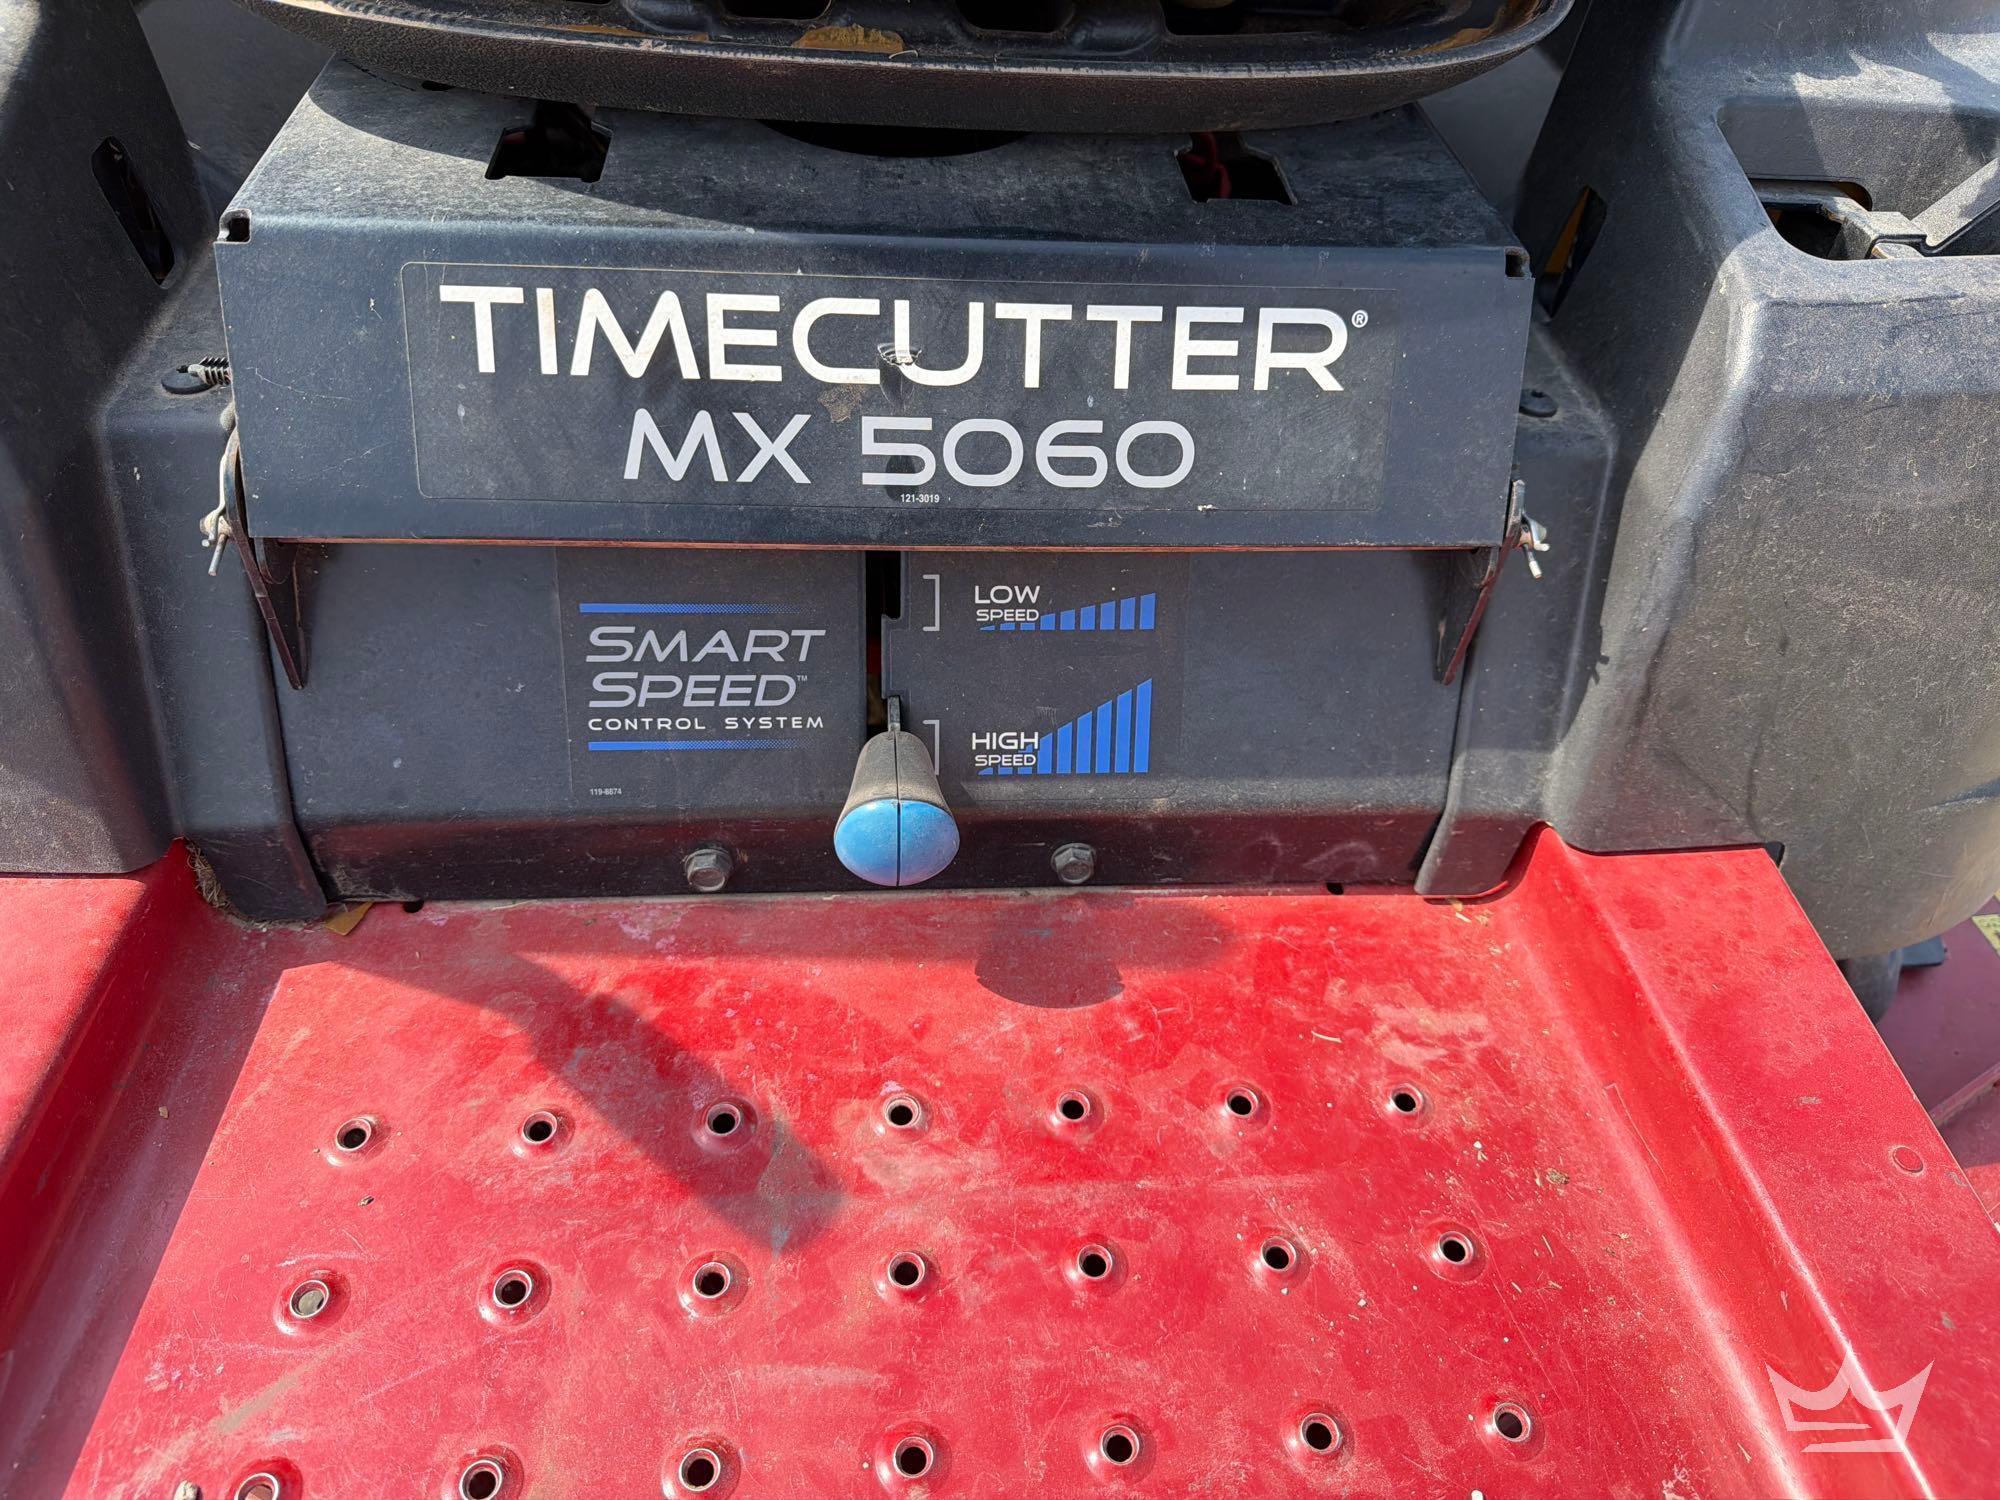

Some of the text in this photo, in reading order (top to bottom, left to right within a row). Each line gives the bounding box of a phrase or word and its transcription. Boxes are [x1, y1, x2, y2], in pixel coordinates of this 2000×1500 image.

[624, 408, 1195, 489] MX 5060
[900, 493, 940, 504] 121-3019
[974, 585, 1040, 604] LOW
[976, 608, 1040, 622] SPEED
[586, 626, 826, 662] SMART
[588, 716, 824, 731] CONTROL SYSTEM
[971, 731, 1039, 750] HIGH
[974, 754, 1037, 767] SPEED
